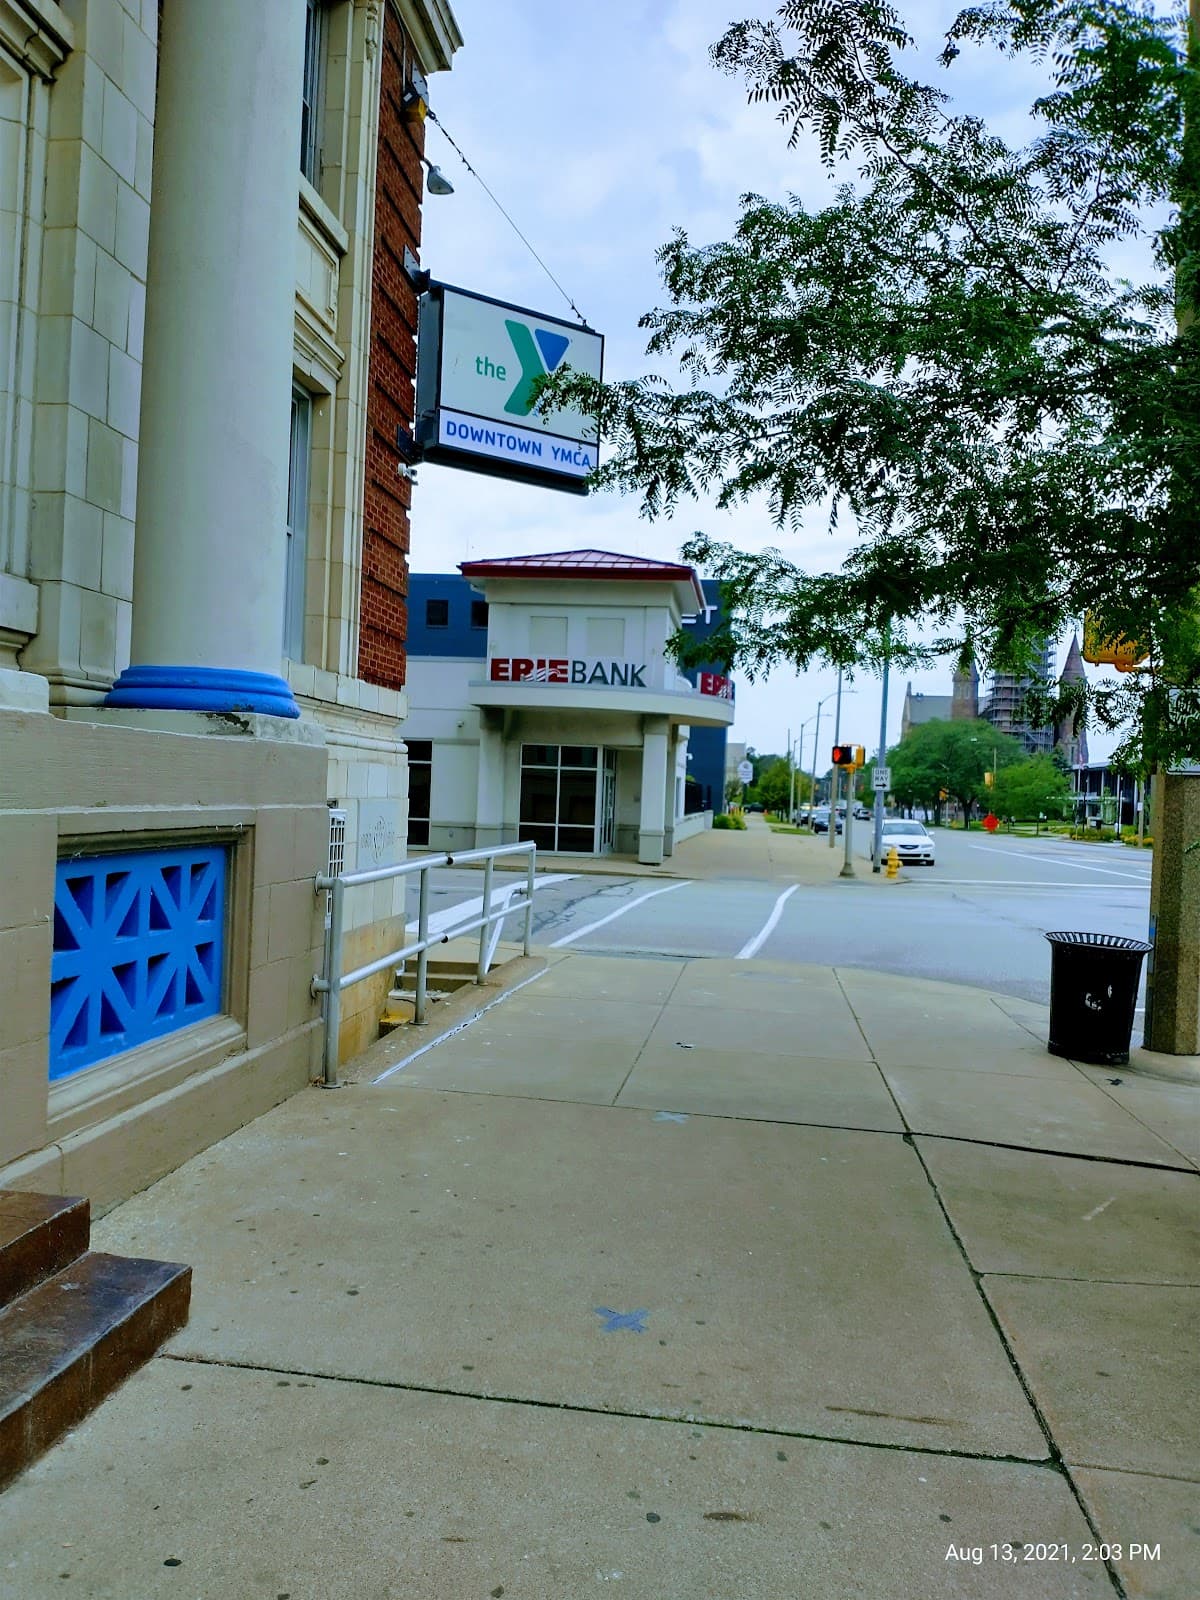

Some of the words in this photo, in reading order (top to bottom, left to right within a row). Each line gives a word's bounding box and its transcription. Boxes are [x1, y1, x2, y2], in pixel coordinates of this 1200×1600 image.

[475, 356, 507, 381] the
[446, 420, 542, 457] DOWNTOWN
[552, 446, 590, 468] YMCA
